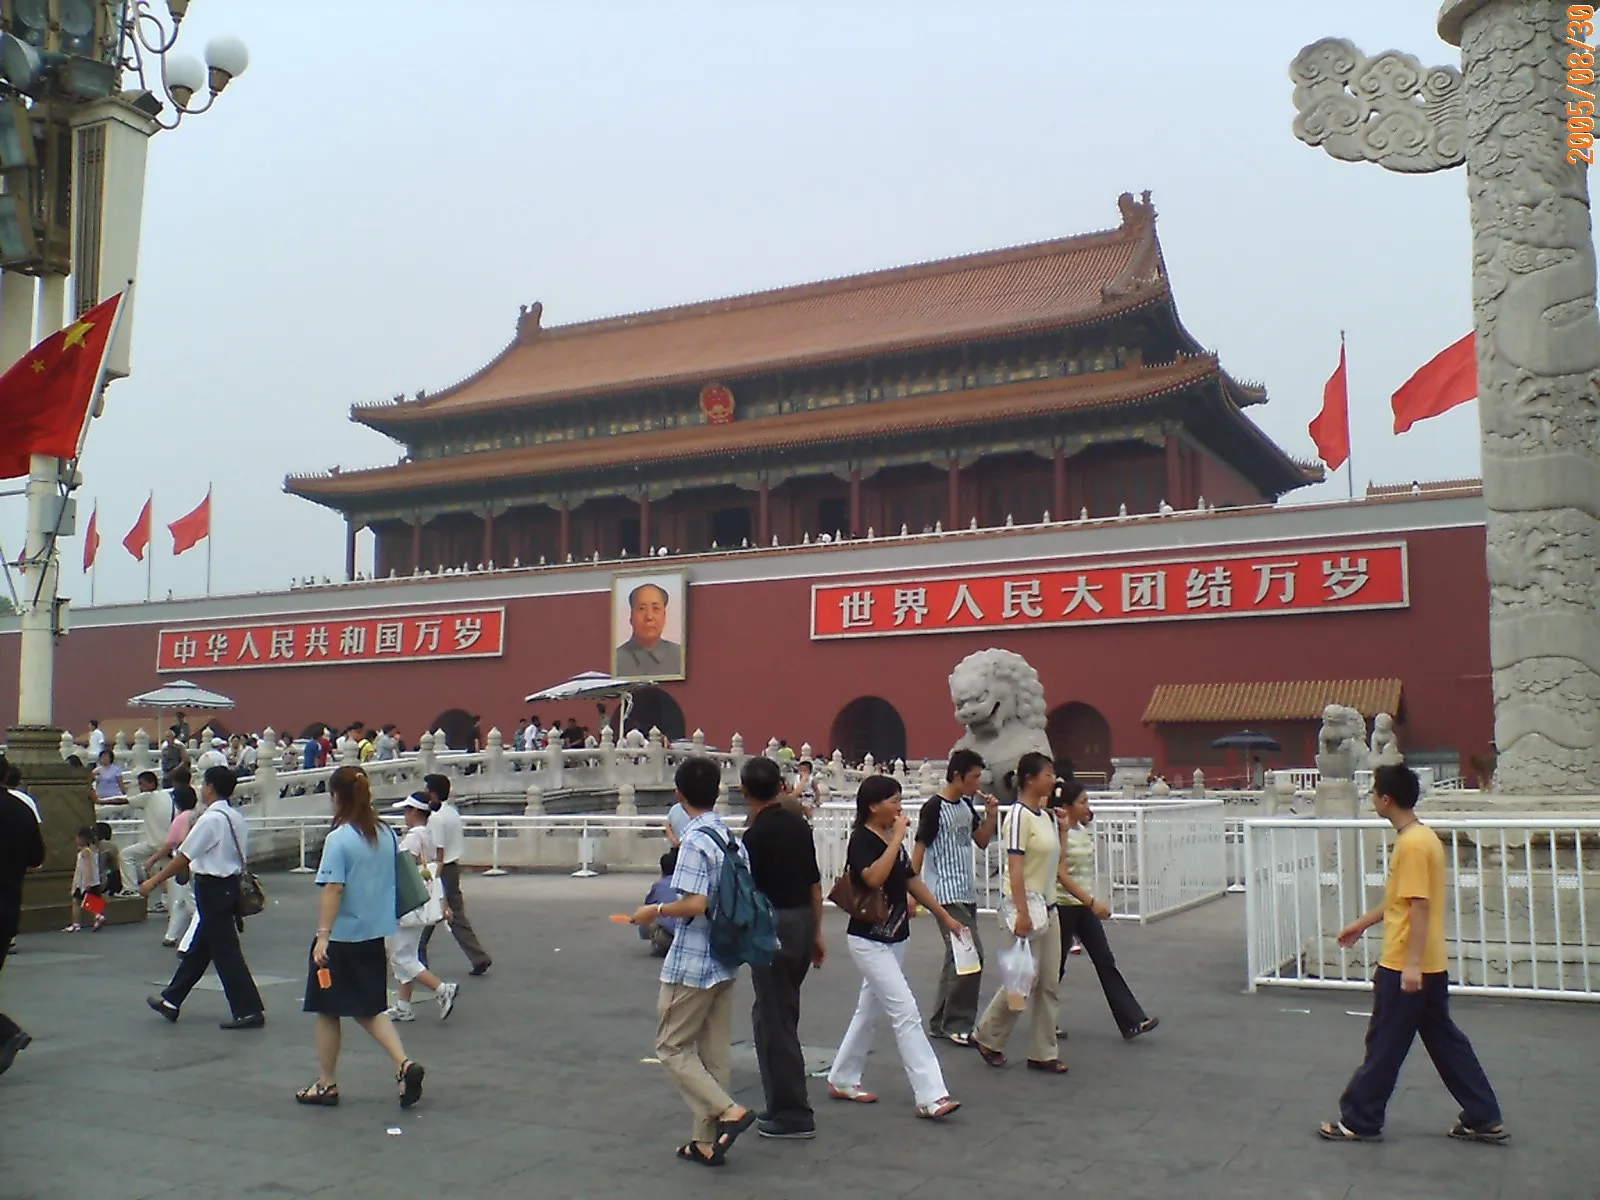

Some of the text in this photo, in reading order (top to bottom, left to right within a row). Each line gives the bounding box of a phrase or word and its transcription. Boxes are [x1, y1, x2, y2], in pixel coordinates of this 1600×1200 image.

[838, 556, 1370, 629] 世界人民大团结万岁
[173, 617, 483, 664] 中华人民共和国万岁
